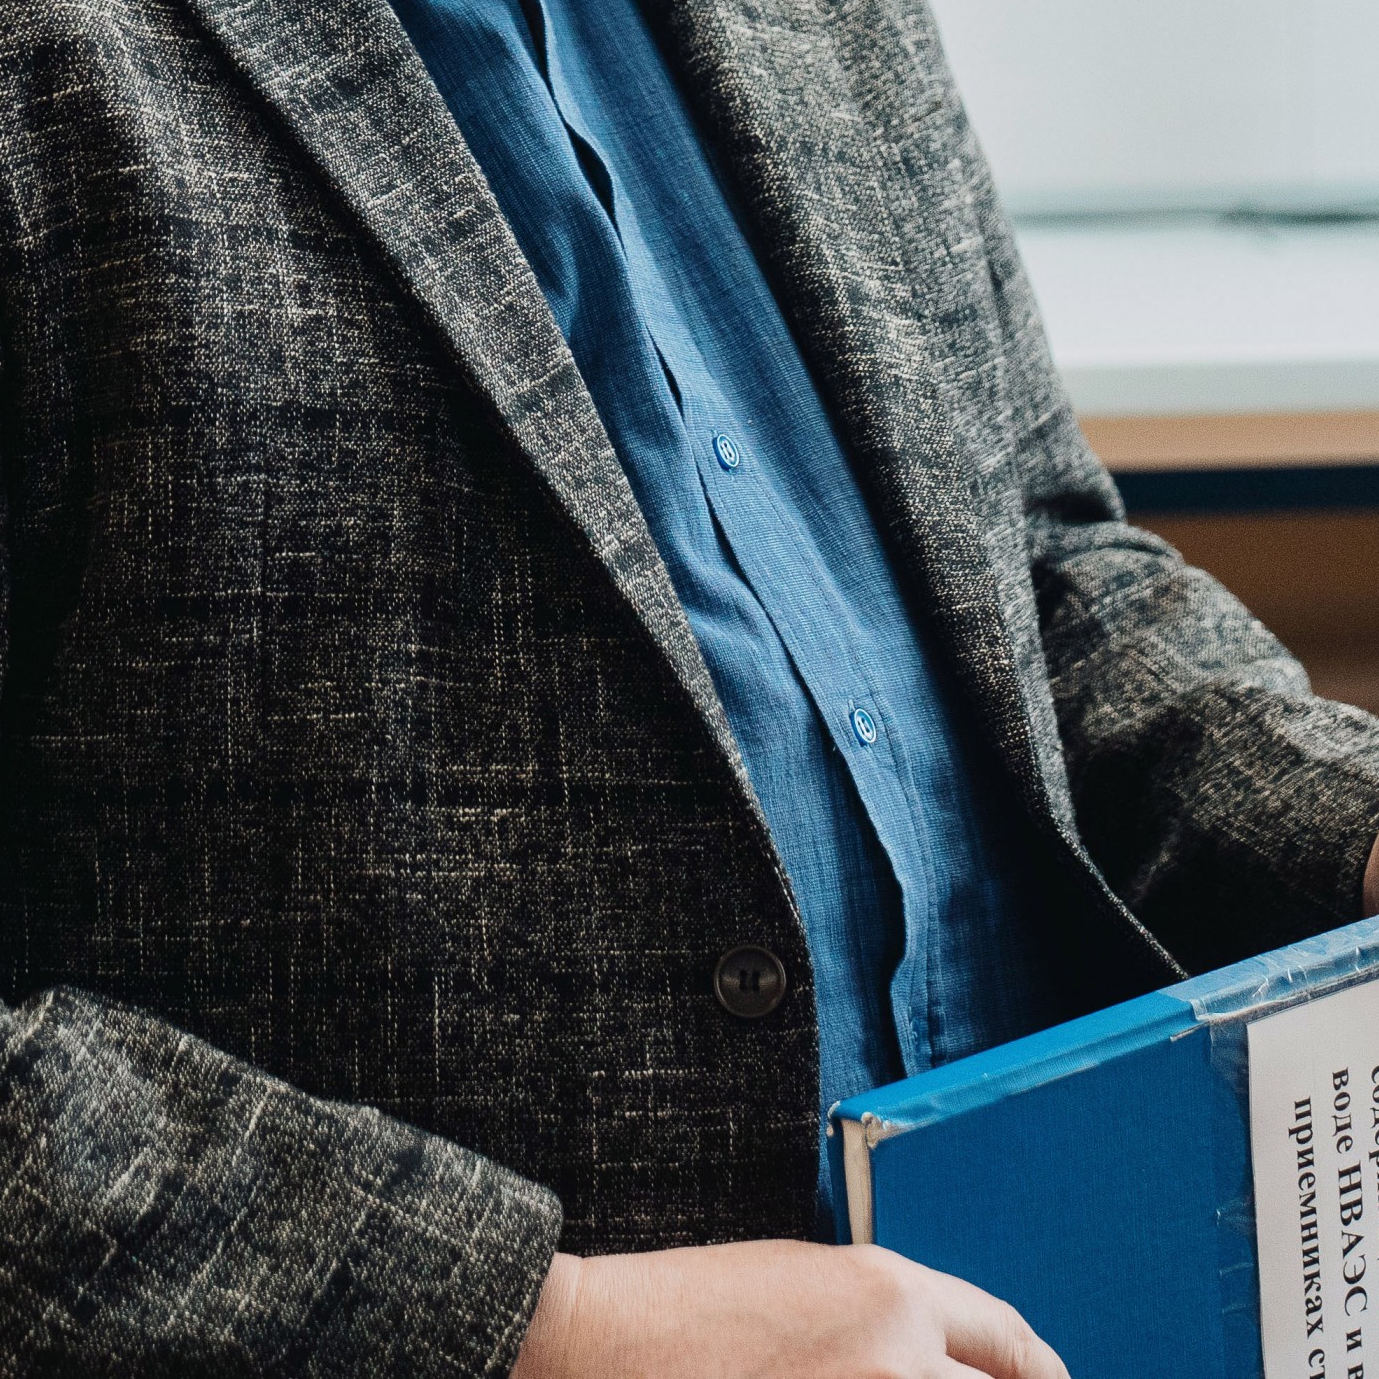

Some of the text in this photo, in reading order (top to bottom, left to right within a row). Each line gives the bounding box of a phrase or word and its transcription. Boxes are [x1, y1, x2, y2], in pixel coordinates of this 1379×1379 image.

[1332, 1066, 1353, 1154] воде
[1288, 1095, 1324, 1339] приемниках
[1338, 1160, 1368, 1316] НВАЭС
[1346, 1327, 1362, 1352] и
